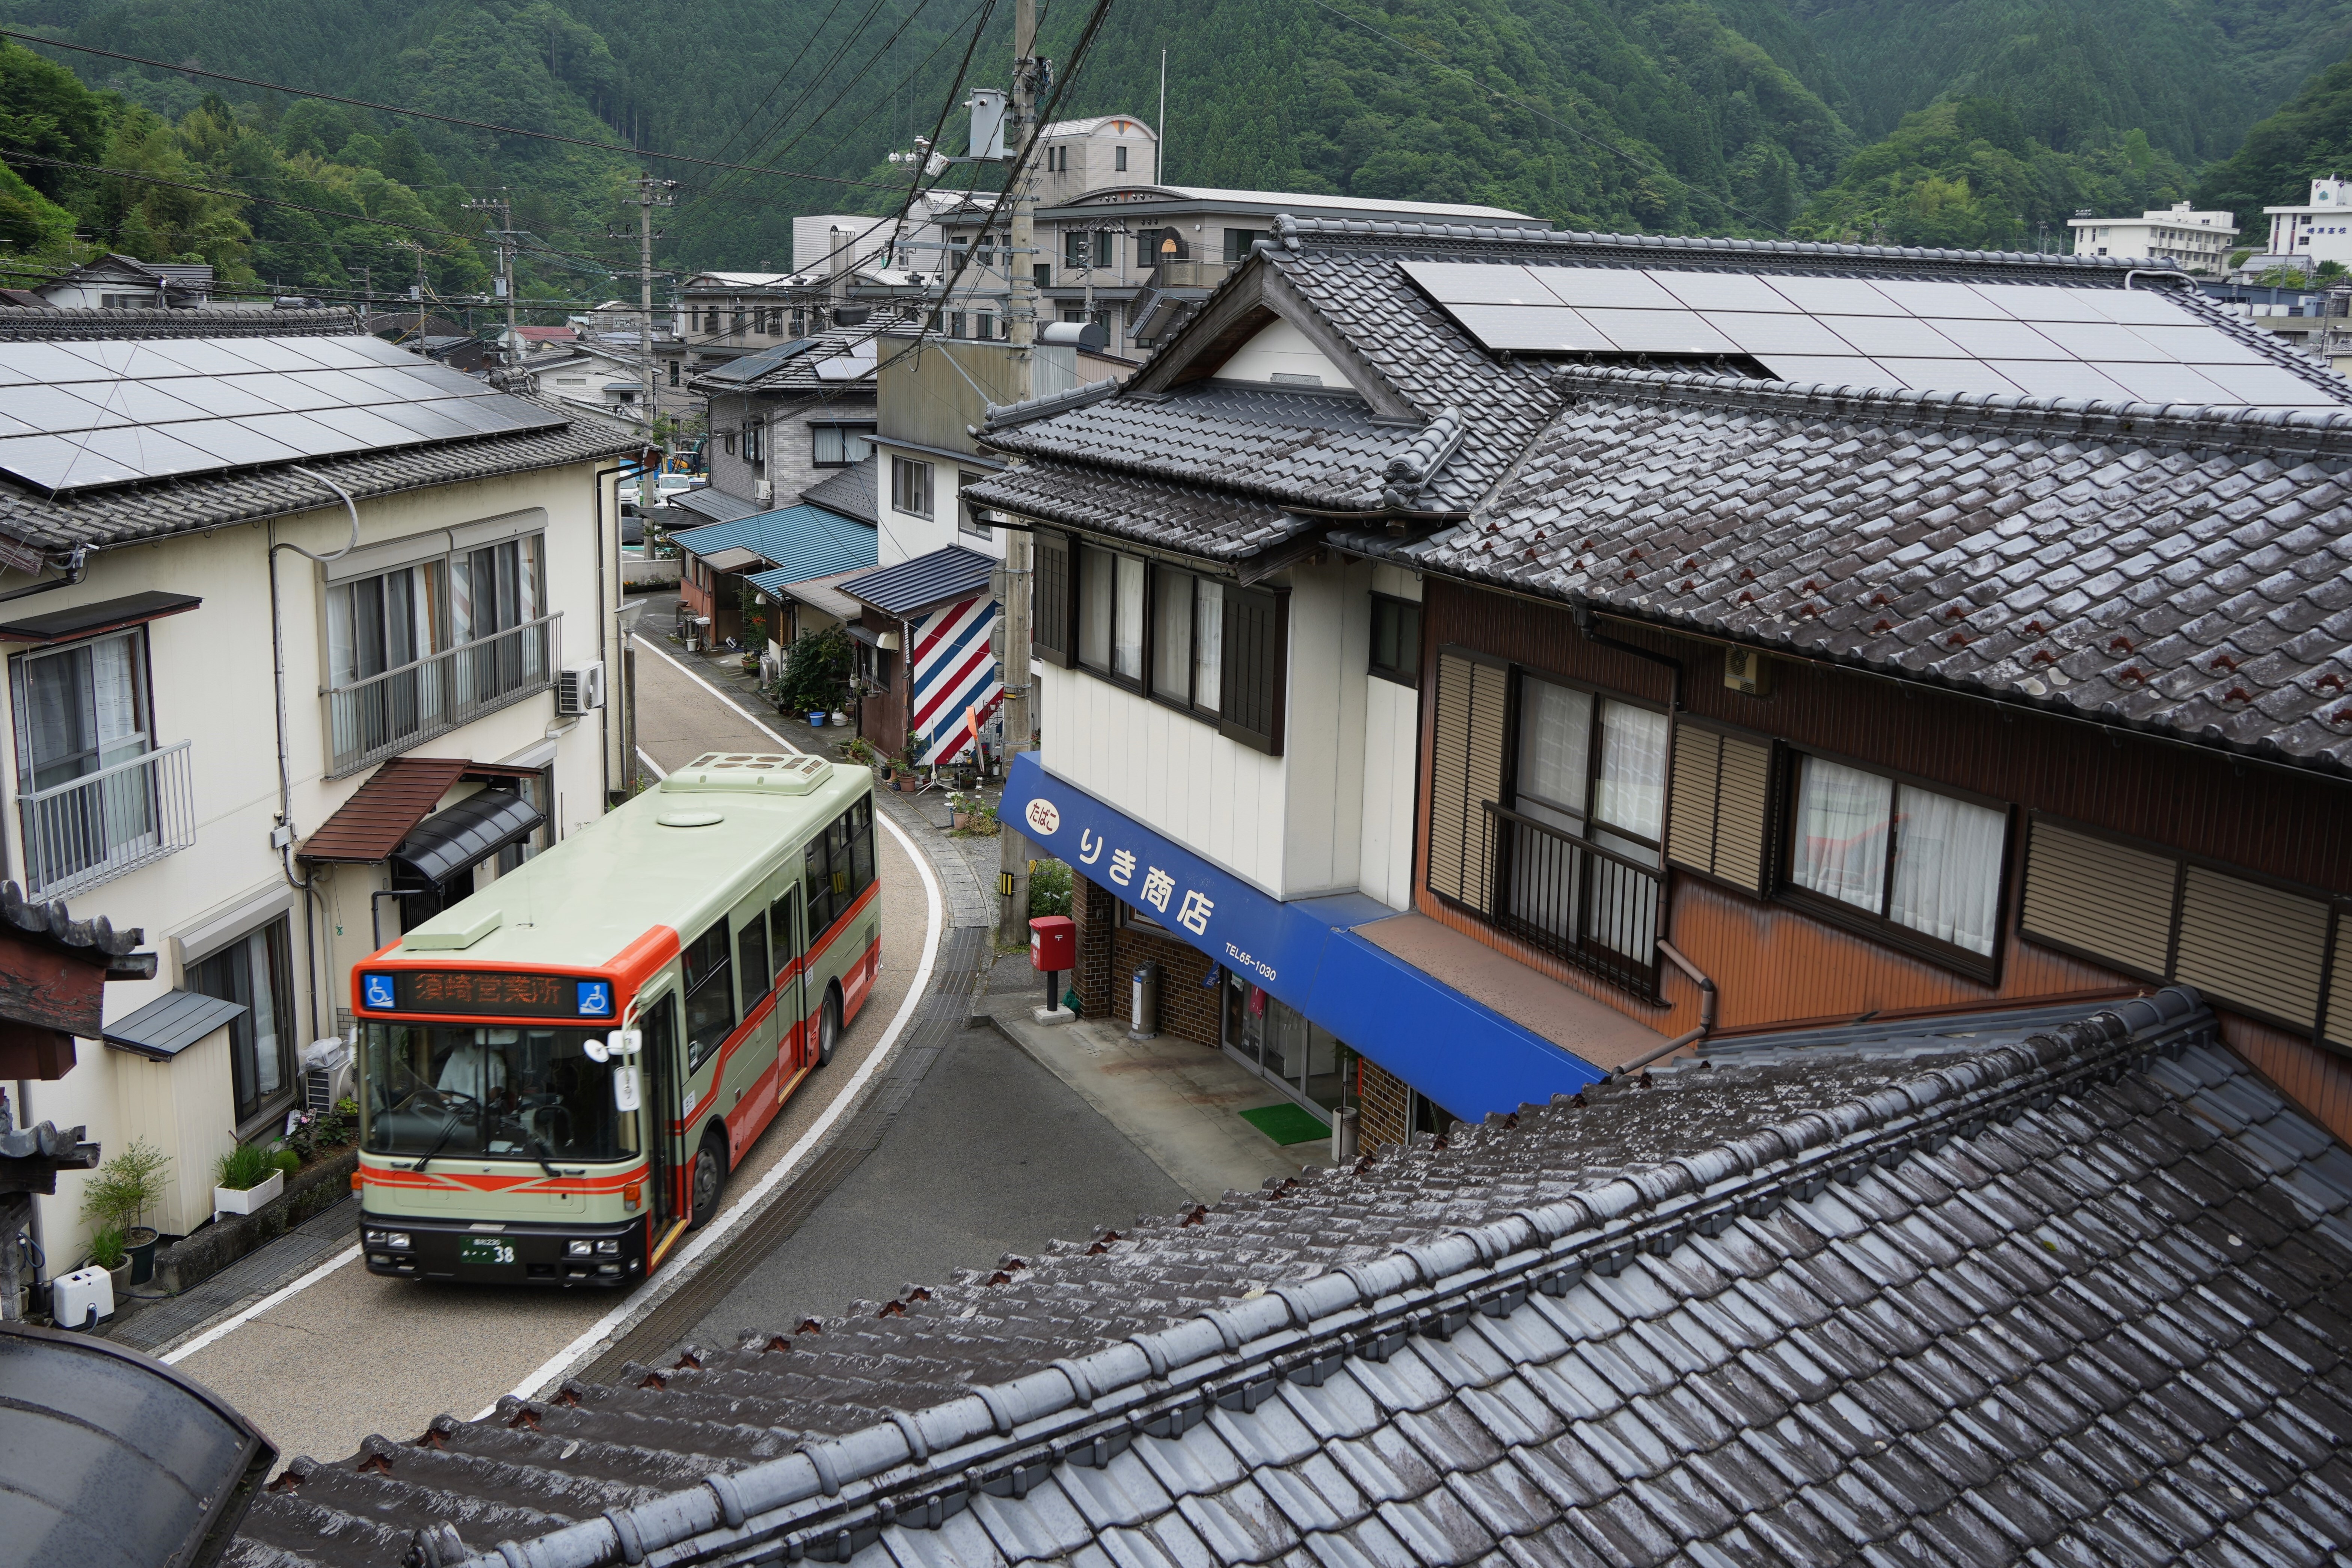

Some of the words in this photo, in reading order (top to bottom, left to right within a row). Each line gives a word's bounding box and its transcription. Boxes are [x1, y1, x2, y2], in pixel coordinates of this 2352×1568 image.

[1029, 803, 1056, 832] たばこ
[1079, 829, 1214, 936] りき商店
[493, 1246, 515, 1263] 38
